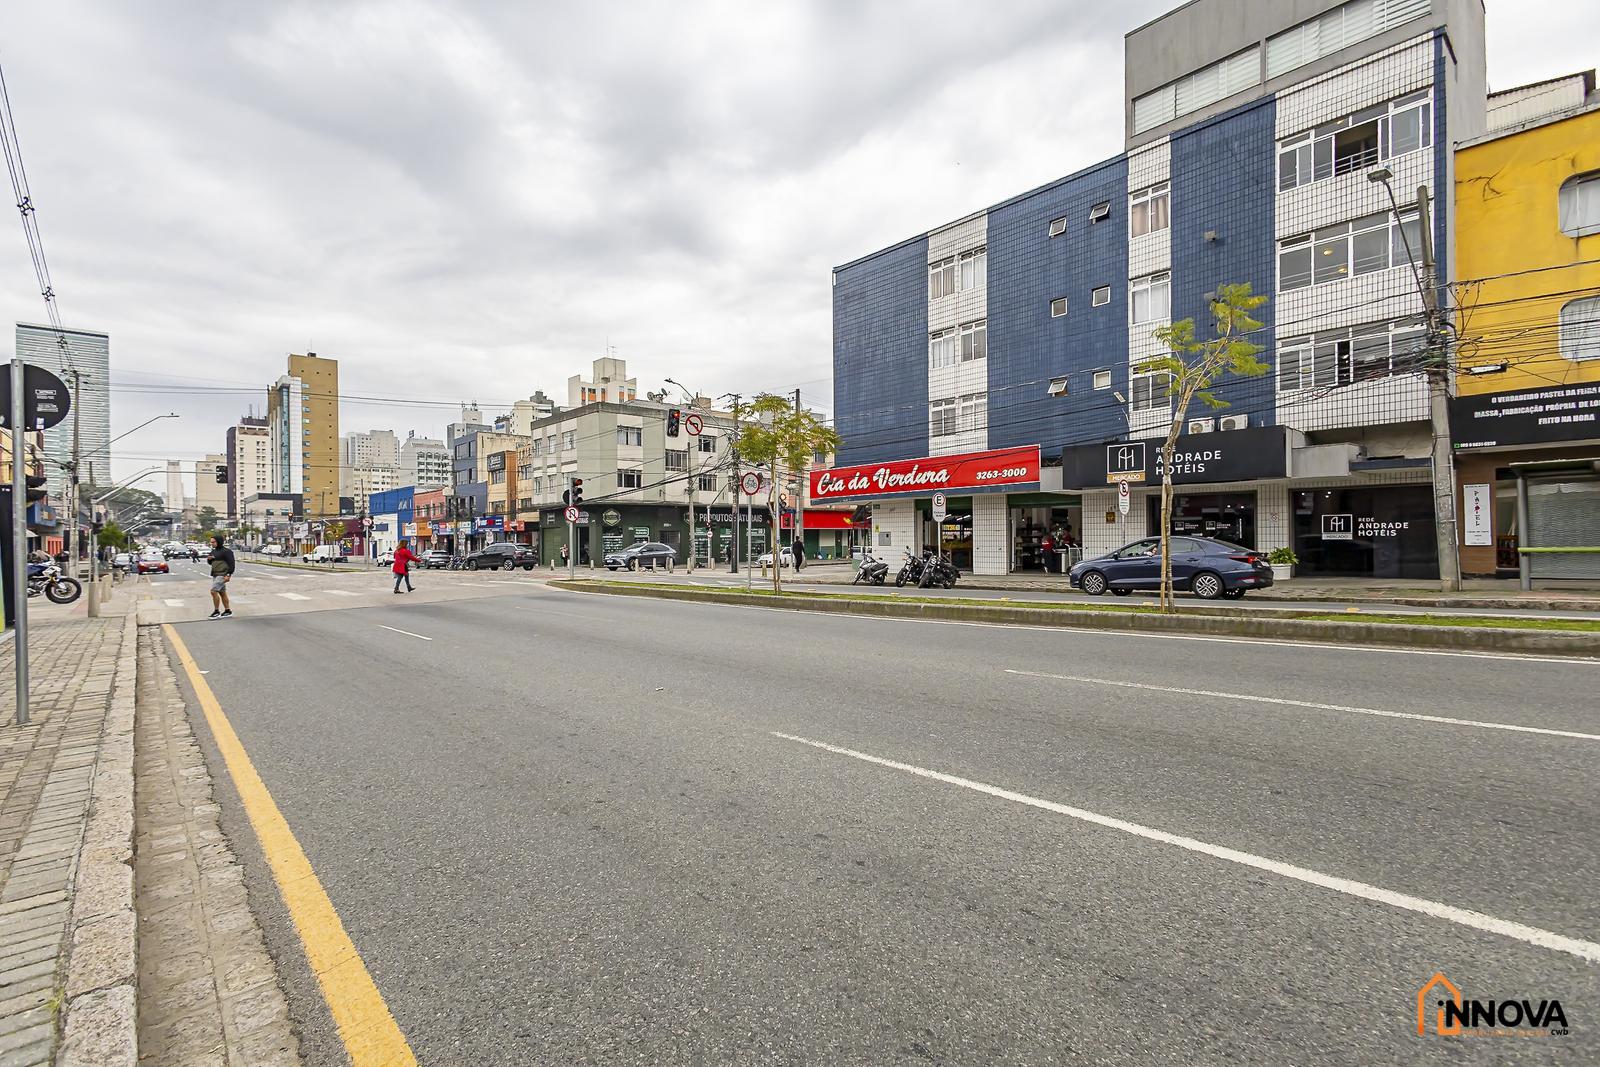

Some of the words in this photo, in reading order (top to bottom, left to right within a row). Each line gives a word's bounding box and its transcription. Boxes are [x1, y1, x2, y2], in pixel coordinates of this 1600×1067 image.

[1497, 392, 1539, 403] VERDADEIRO
[1540, 390, 1565, 399] PASTEL
[1565, 388, 1576, 396] DA
[1577, 386, 1597, 395] FEIRA
[1545, 401, 1576, 412] PRÓPRIA
[1578, 400, 1589, 408] DE
[1538, 416, 1560, 425] FRITO
[1561, 415, 1572, 423] NA
[1572, 413, 1595, 422] HORA
[1155, 462, 1205, 476] HOTÉIS
[817, 472, 846, 495] Cia
[848, 472, 870, 491] da
[873, 464, 950, 490] Verdura
[976, 467, 1027, 481] 3263-3000
[737, 514, 763, 523] ATURAIS
[1358, 528, 1397, 537] HOTÉIS
